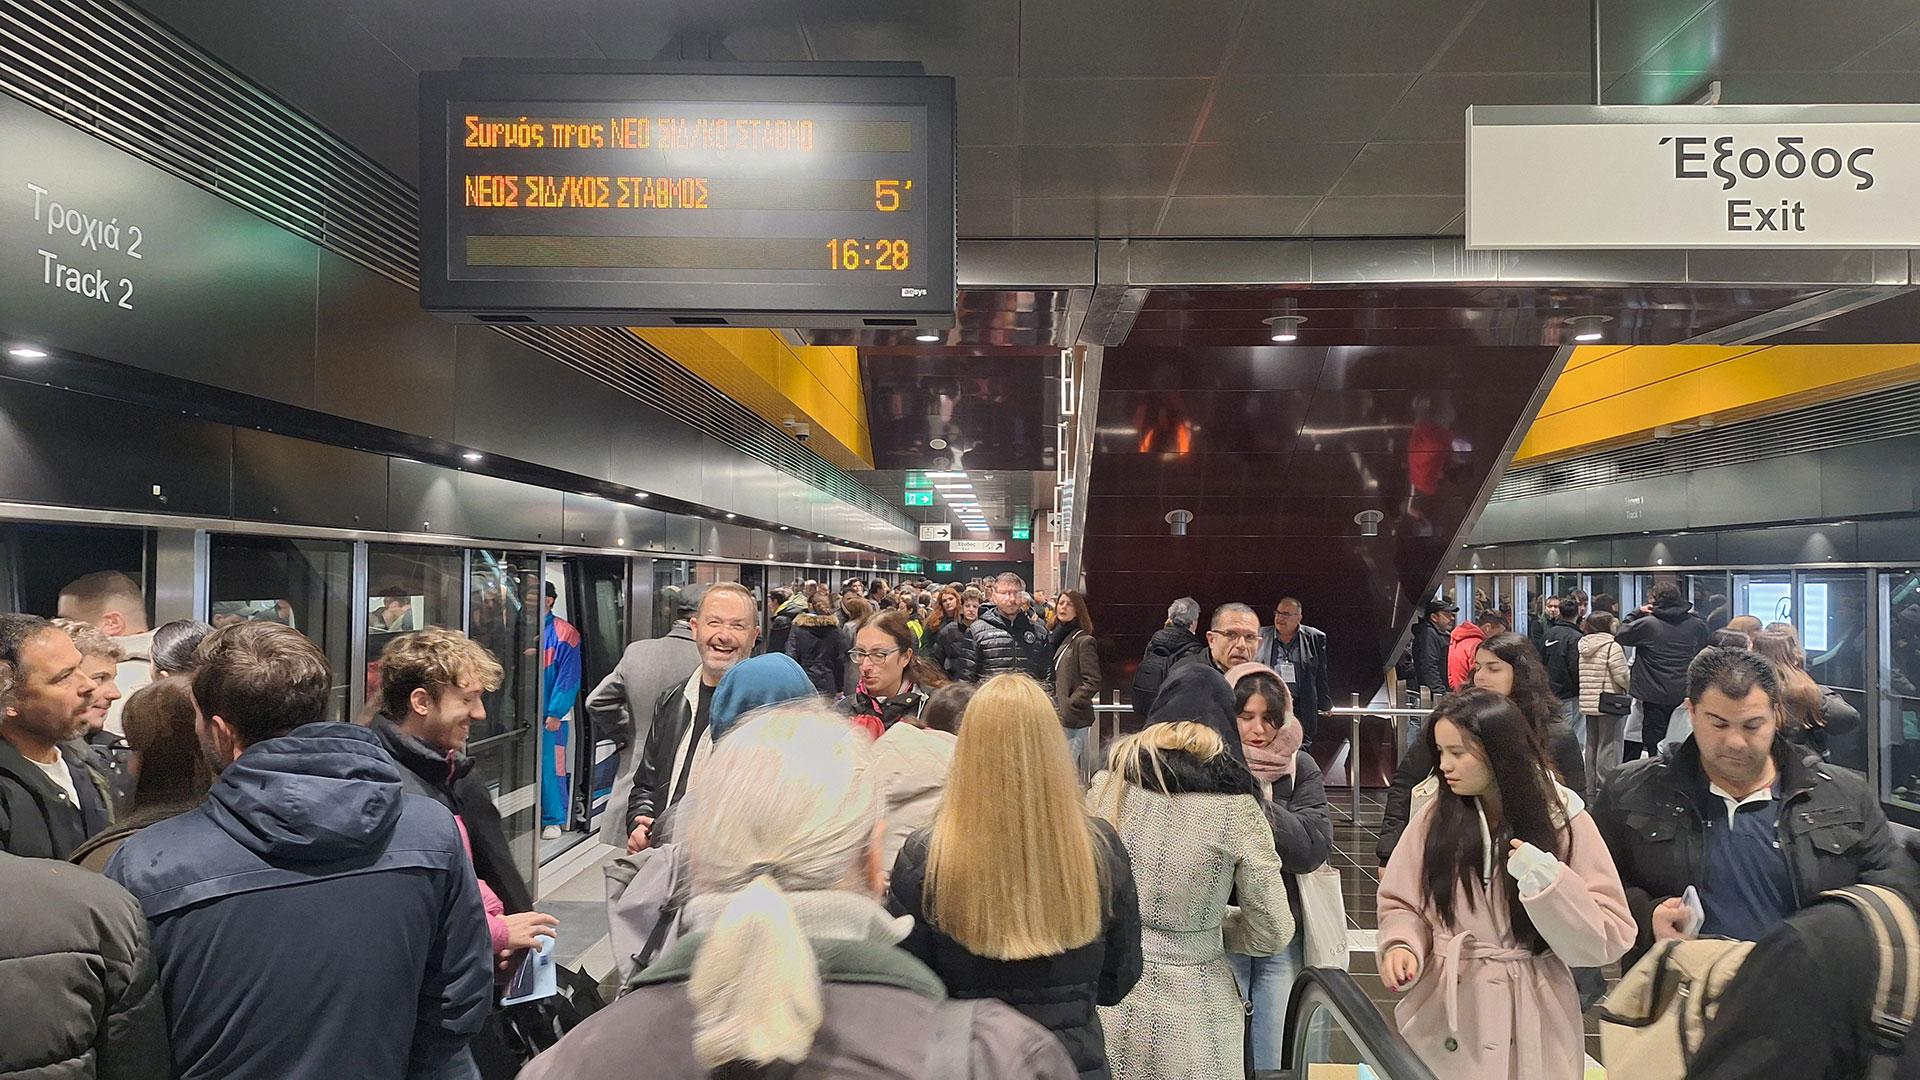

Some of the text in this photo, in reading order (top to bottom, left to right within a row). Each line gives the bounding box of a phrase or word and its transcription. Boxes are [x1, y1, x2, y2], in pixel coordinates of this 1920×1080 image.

[465, 116, 544, 148] Συρμός
[551, 124, 604, 148] προς
[611, 117, 650, 149] ΝΕΟ
[736, 119, 813, 150] ΣΤΑΘΜΟ
[1658, 137, 1875, 190] Έξοδος
[465, 176, 519, 207] ΝΕΟΣ
[525, 176, 610, 208] ΣΙΔ/ΚΟΣ
[617, 177, 708, 209] ΣΤΑΘΜΟΣ
[27, 183, 143, 259] Τροχιά 2
[1728, 200, 1805, 231] Exit
[826, 239, 909, 270] 16:28
[38, 249, 134, 310] Track 2
